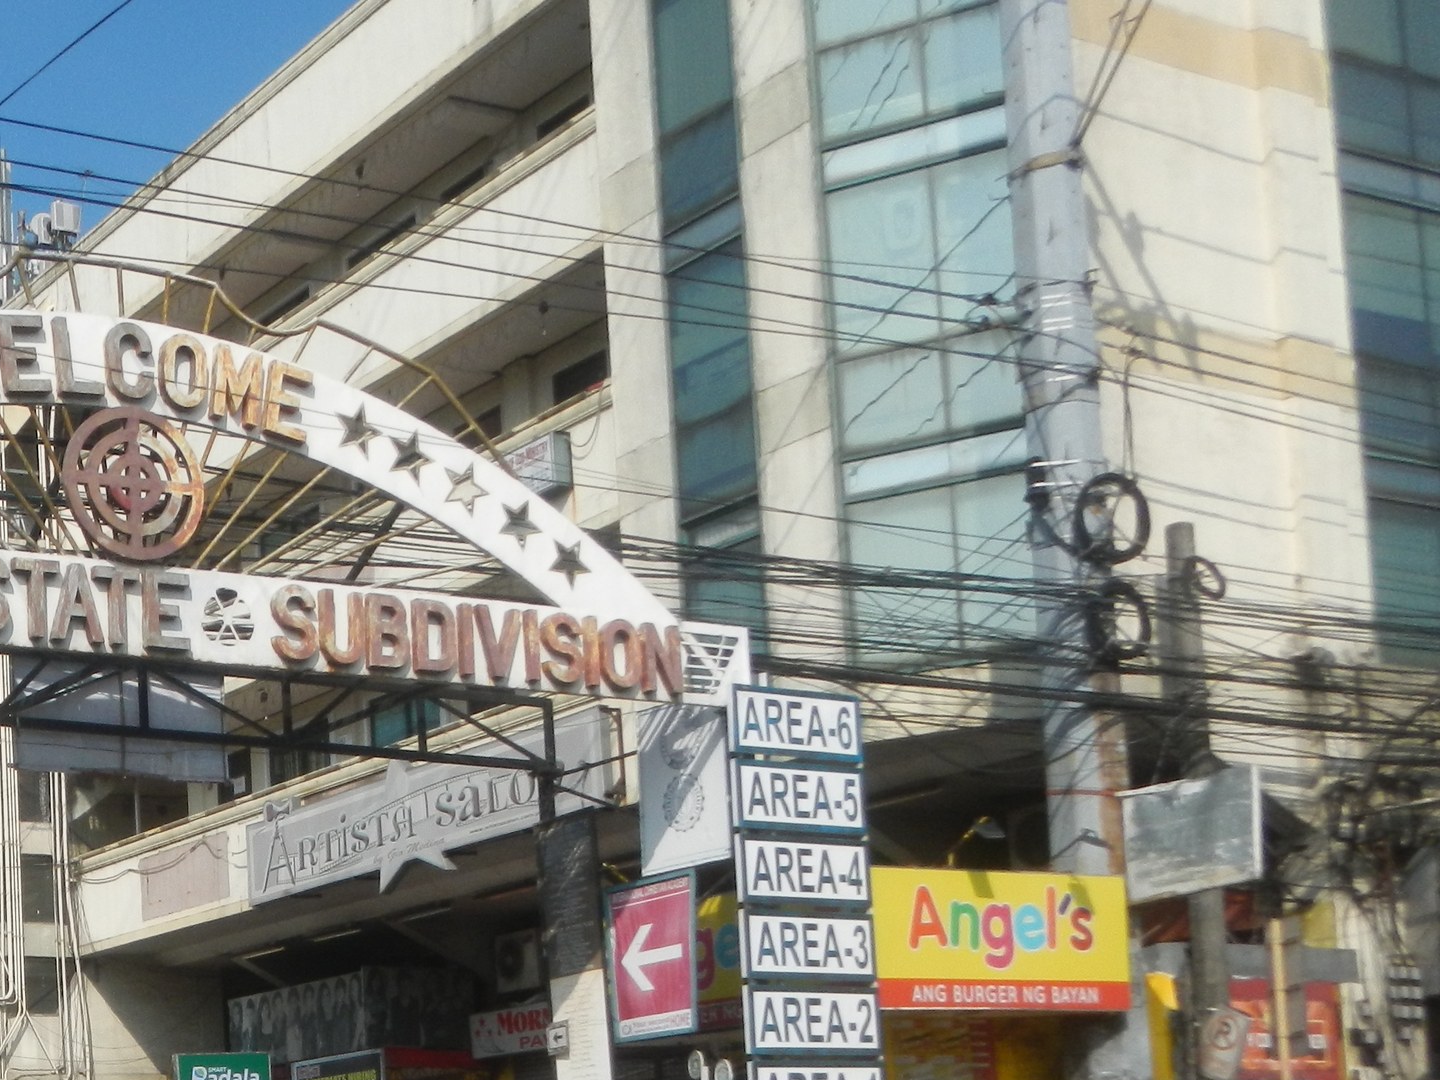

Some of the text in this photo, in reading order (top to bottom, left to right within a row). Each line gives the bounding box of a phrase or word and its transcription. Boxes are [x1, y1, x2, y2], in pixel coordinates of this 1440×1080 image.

[269, 583, 683, 697] SUBDIVISION
[742, 696, 853, 750] AREA-6
[747, 771, 859, 823] AREA-5
[752, 844, 863, 896] AREA-4
[758, 920, 869, 969] AREA-3
[907, 885, 1094, 971] Angel's
[760, 992, 874, 1043] AREA-2
[912, 984, 1100, 1005] ANG BURGER NG BAYAN
